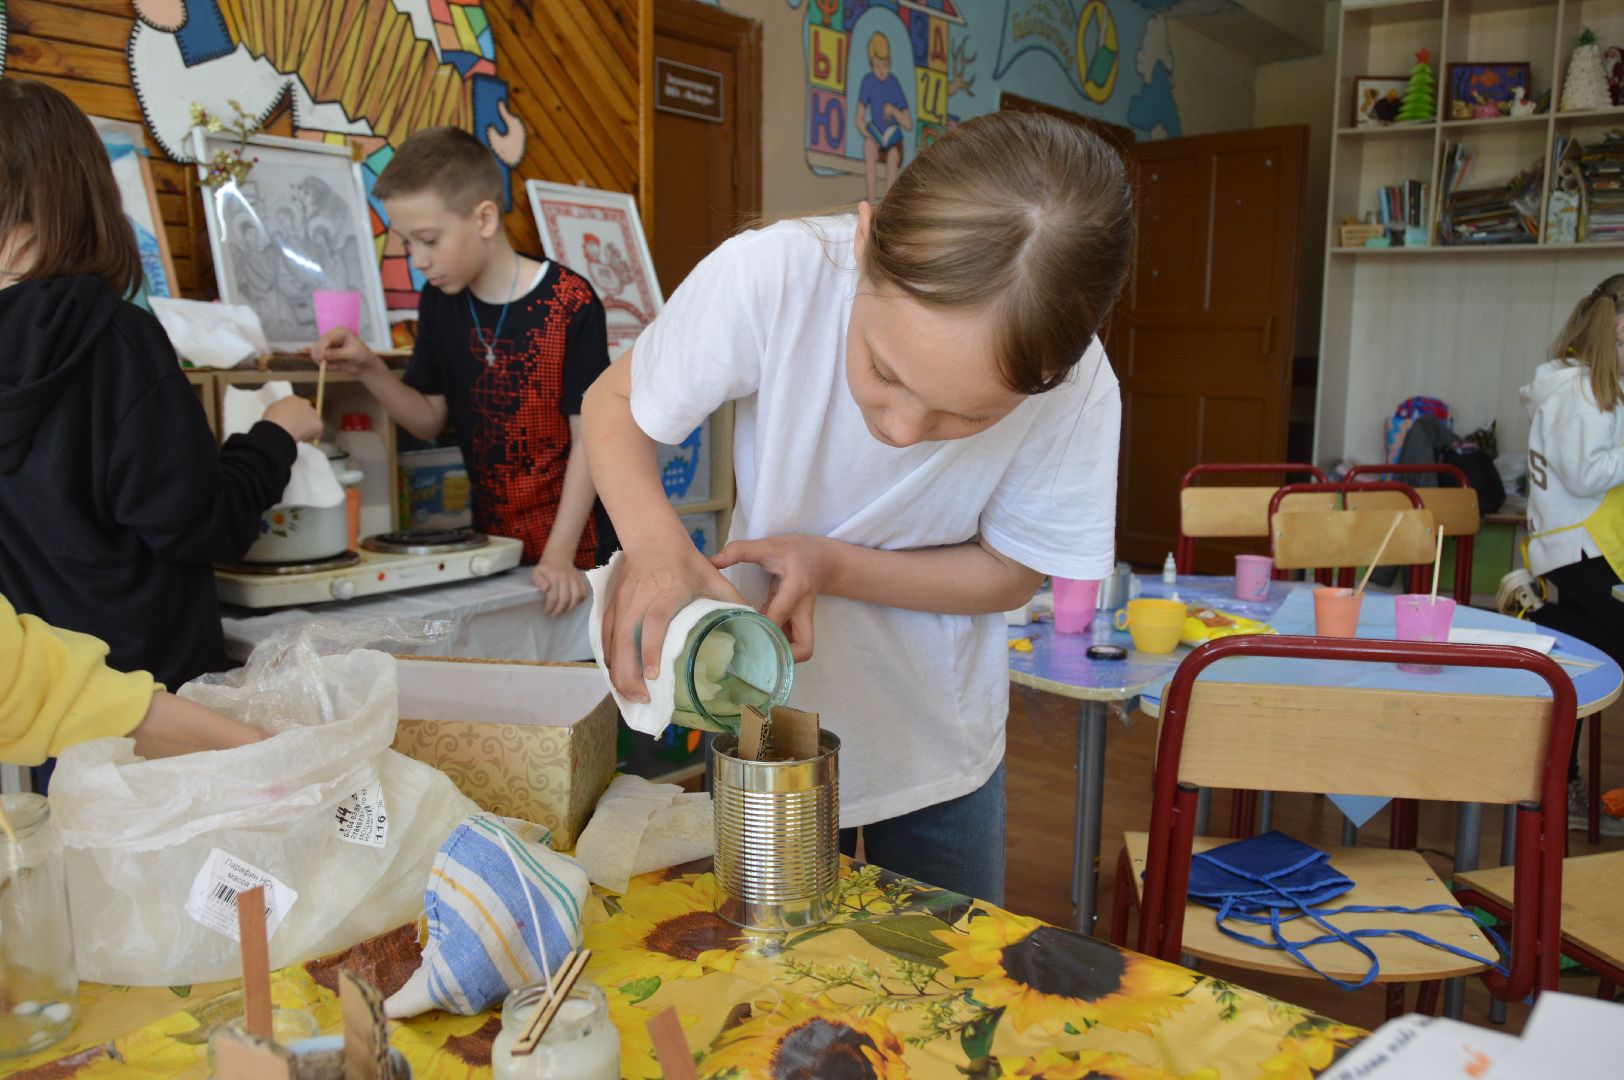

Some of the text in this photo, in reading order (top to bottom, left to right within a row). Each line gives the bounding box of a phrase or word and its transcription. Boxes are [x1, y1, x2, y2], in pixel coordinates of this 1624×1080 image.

[813, 29, 843, 84] Ы
[930, 25, 947, 64] Д
[811, 92, 846, 149] Ю
[375, 815, 386, 841] 116
[224, 857, 259, 881] Парафин
